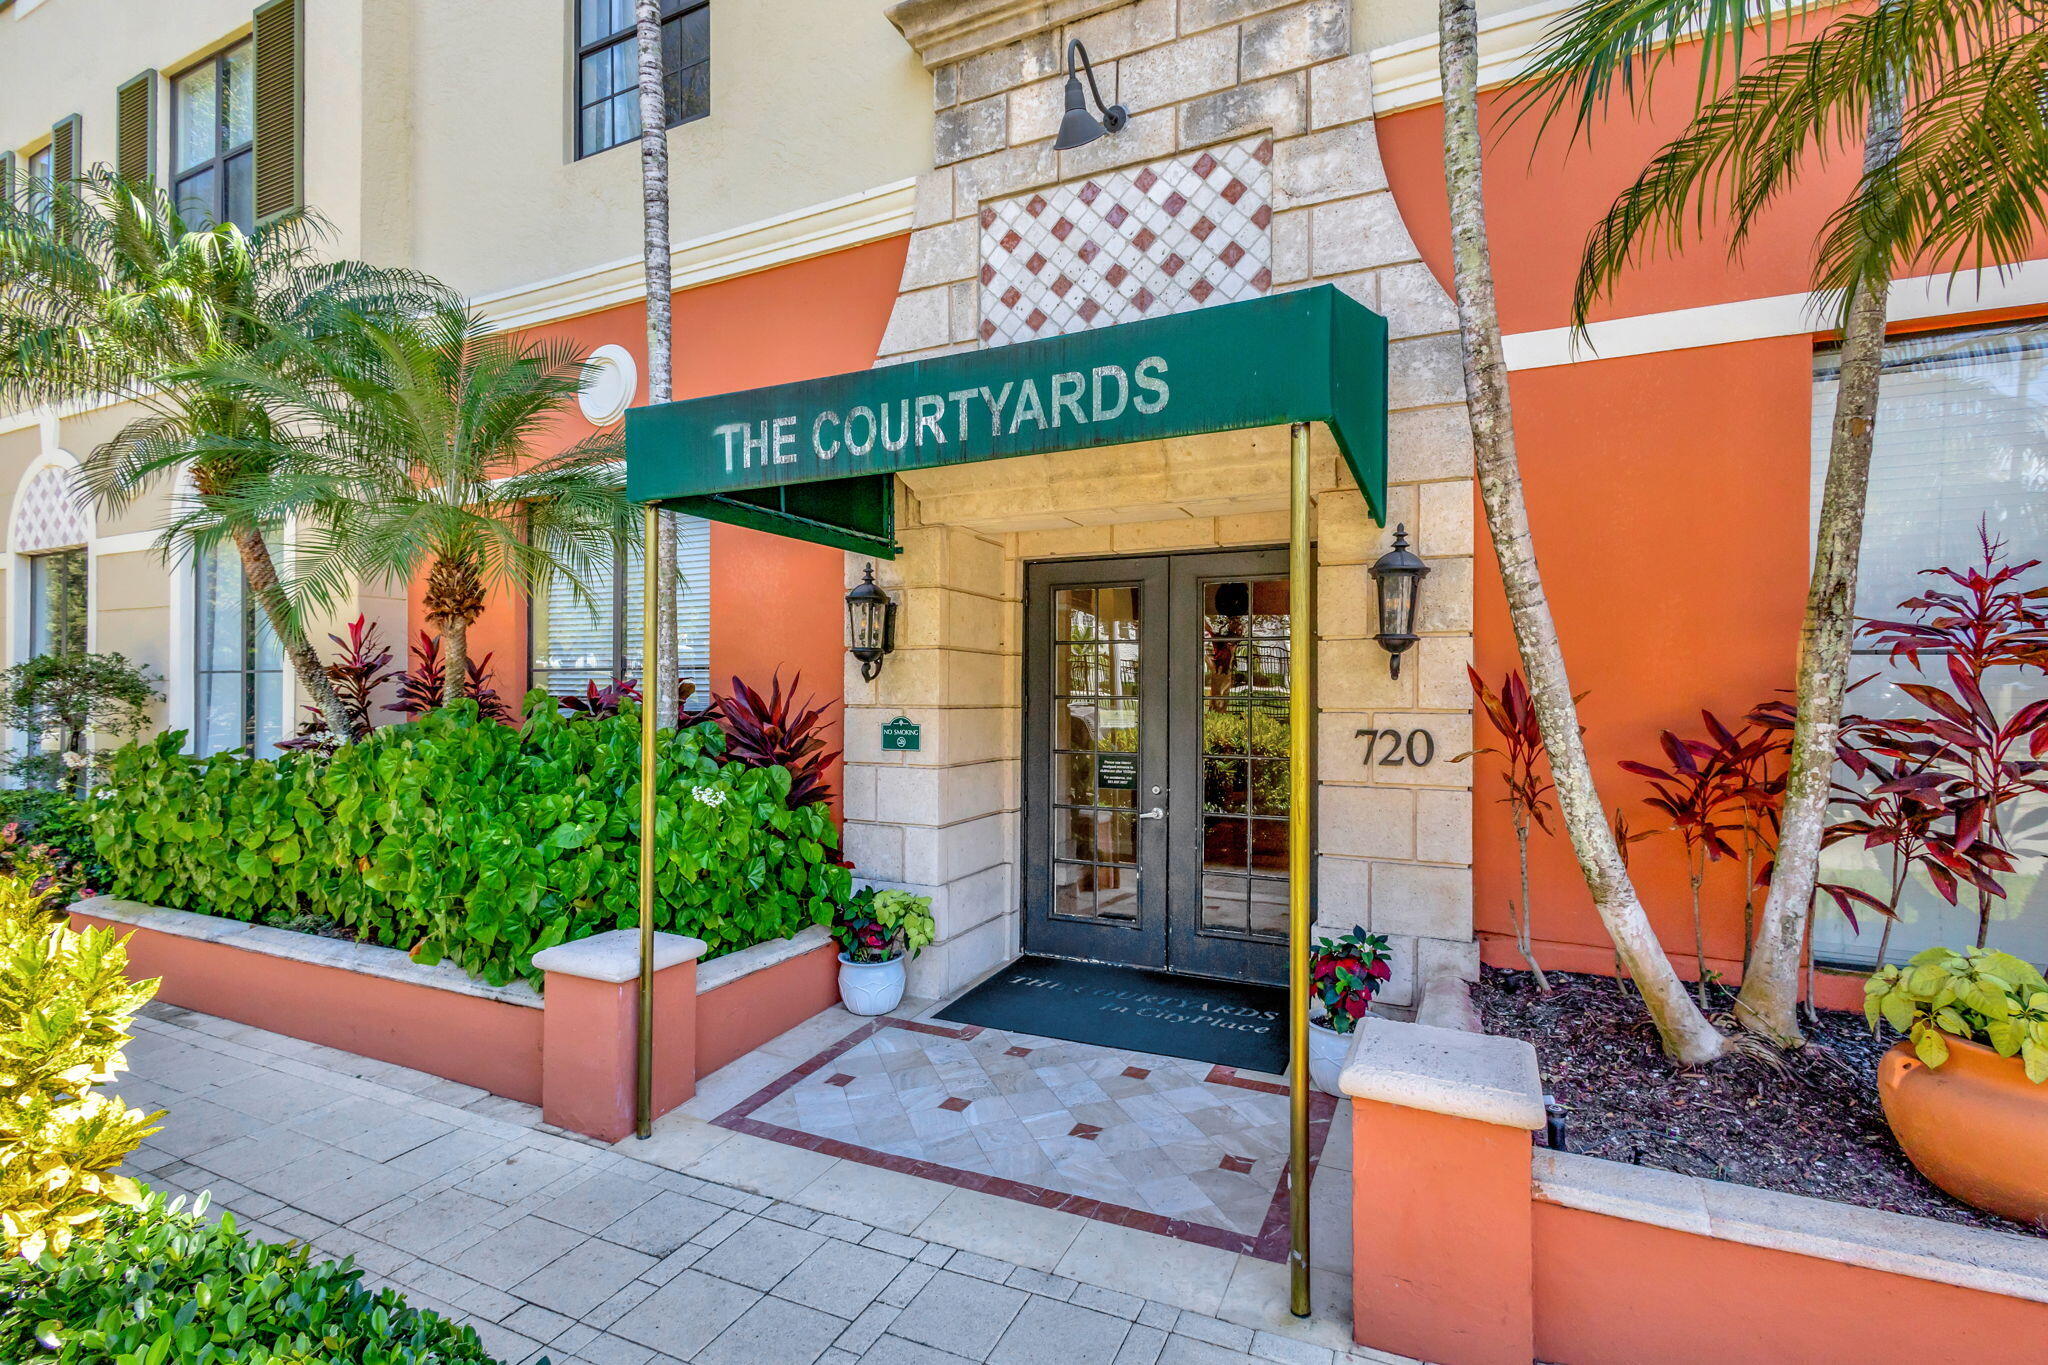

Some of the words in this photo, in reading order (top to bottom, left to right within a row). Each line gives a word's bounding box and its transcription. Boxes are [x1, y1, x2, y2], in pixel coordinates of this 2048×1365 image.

[713, 415, 798, 474] THE
[811, 356, 1170, 460] COURTYARDS
[1354, 729, 1434, 767] 720
[1009, 975, 1066, 991] THE
